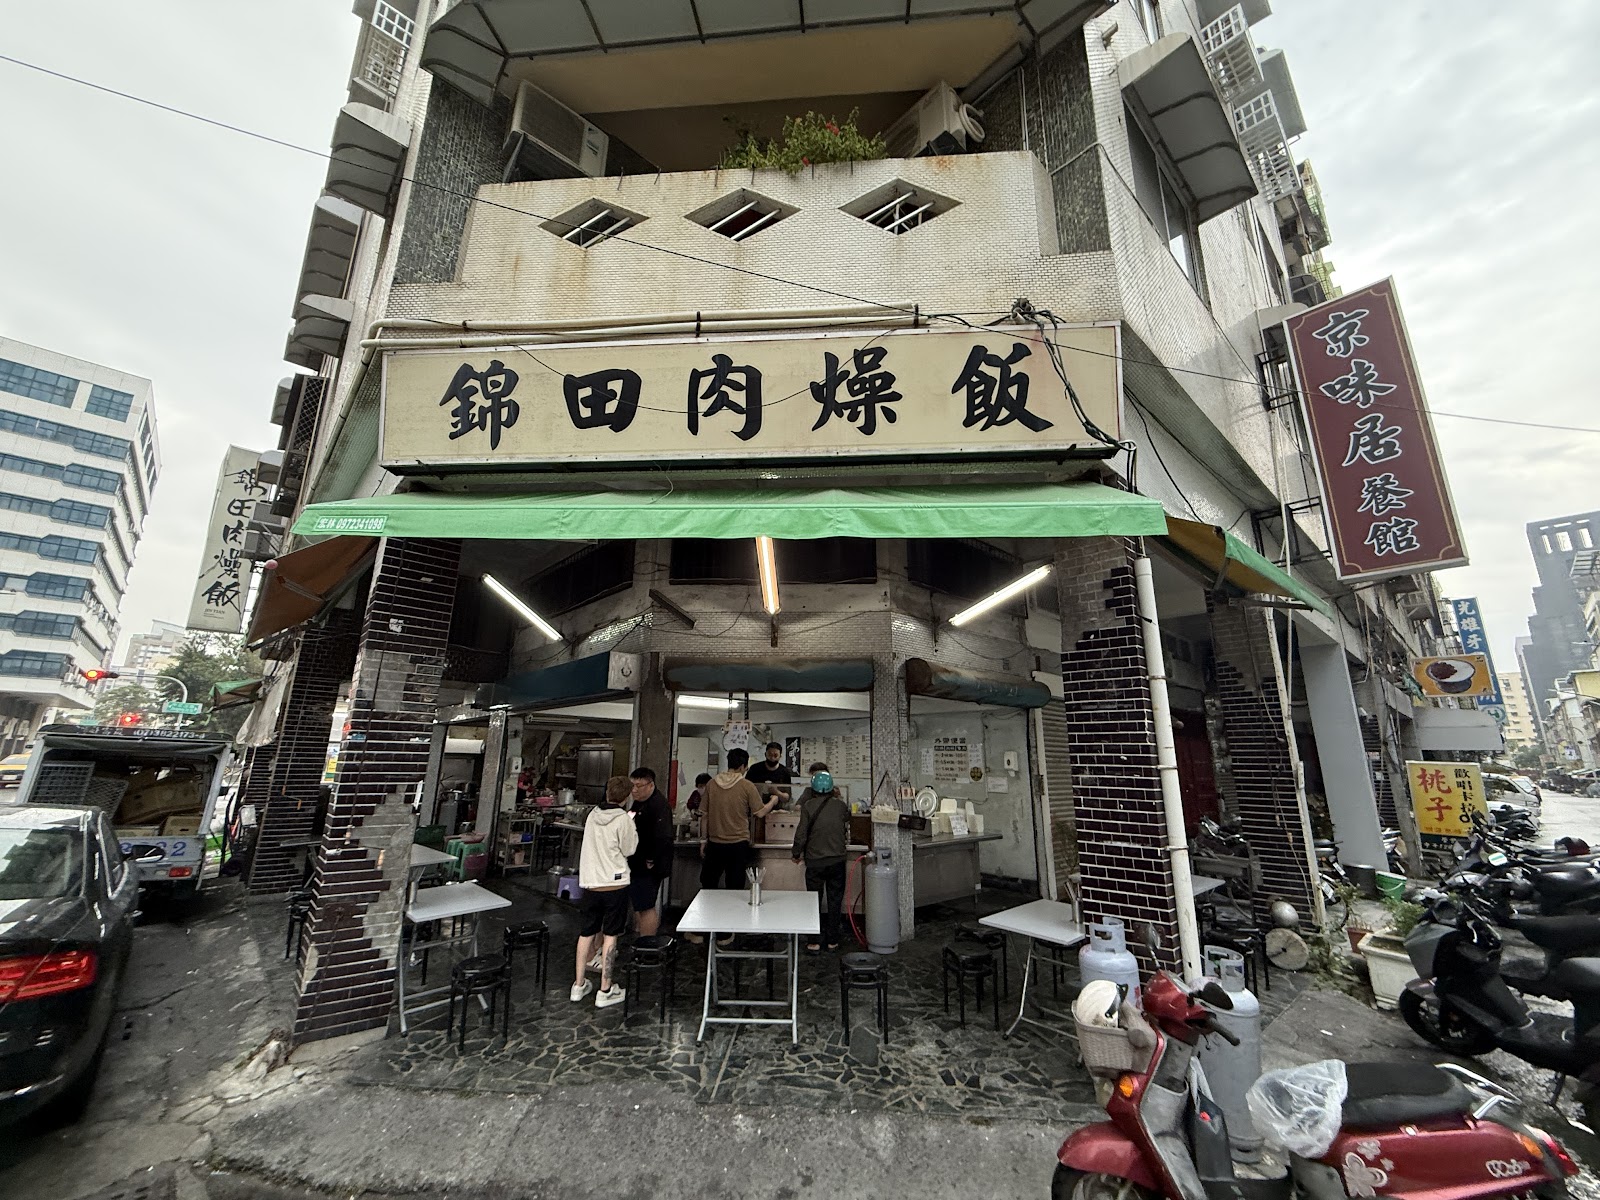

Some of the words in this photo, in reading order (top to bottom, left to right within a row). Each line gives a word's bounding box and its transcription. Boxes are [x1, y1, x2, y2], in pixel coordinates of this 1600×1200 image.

[439, 342, 1054, 451] 錦田肉燥飯
[1312, 308, 1421, 556] 京味居餐館
[1416, 767, 1453, 822] 桃子
